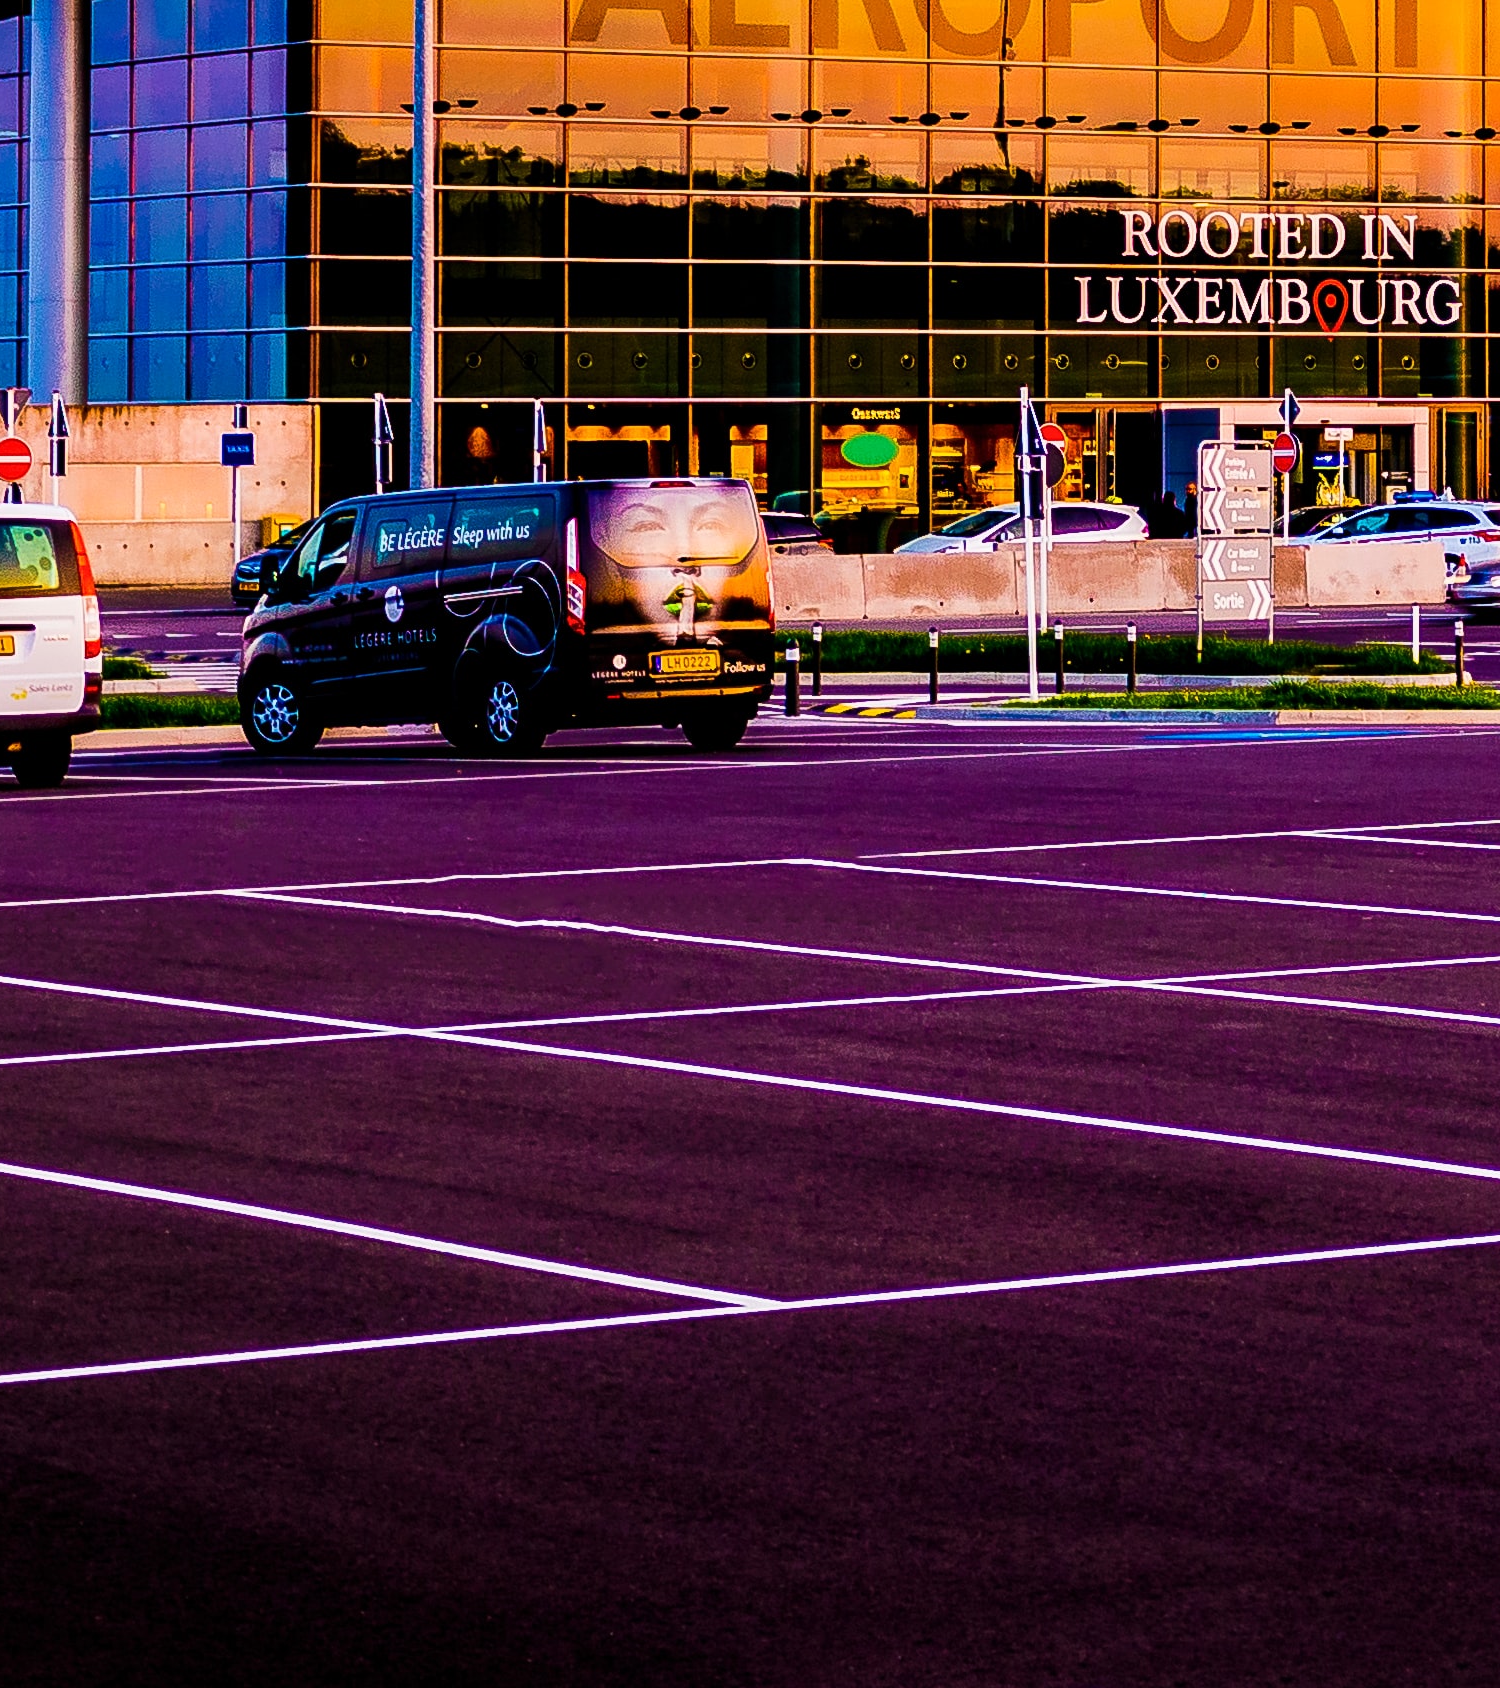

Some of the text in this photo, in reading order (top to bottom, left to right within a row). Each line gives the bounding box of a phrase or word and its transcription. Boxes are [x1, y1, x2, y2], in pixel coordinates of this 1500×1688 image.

[1119, 210, 1419, 261] ROOTED IN
[379, 525, 445, 553] BE LÉGÈRE
[452, 519, 531, 549] Sleep with us
[1213, 592, 1245, 610] Sortie
[397, 628, 438, 645] HOTELS
[666, 655, 711, 670] LH 0222
[723, 661, 766, 674] Follow us
